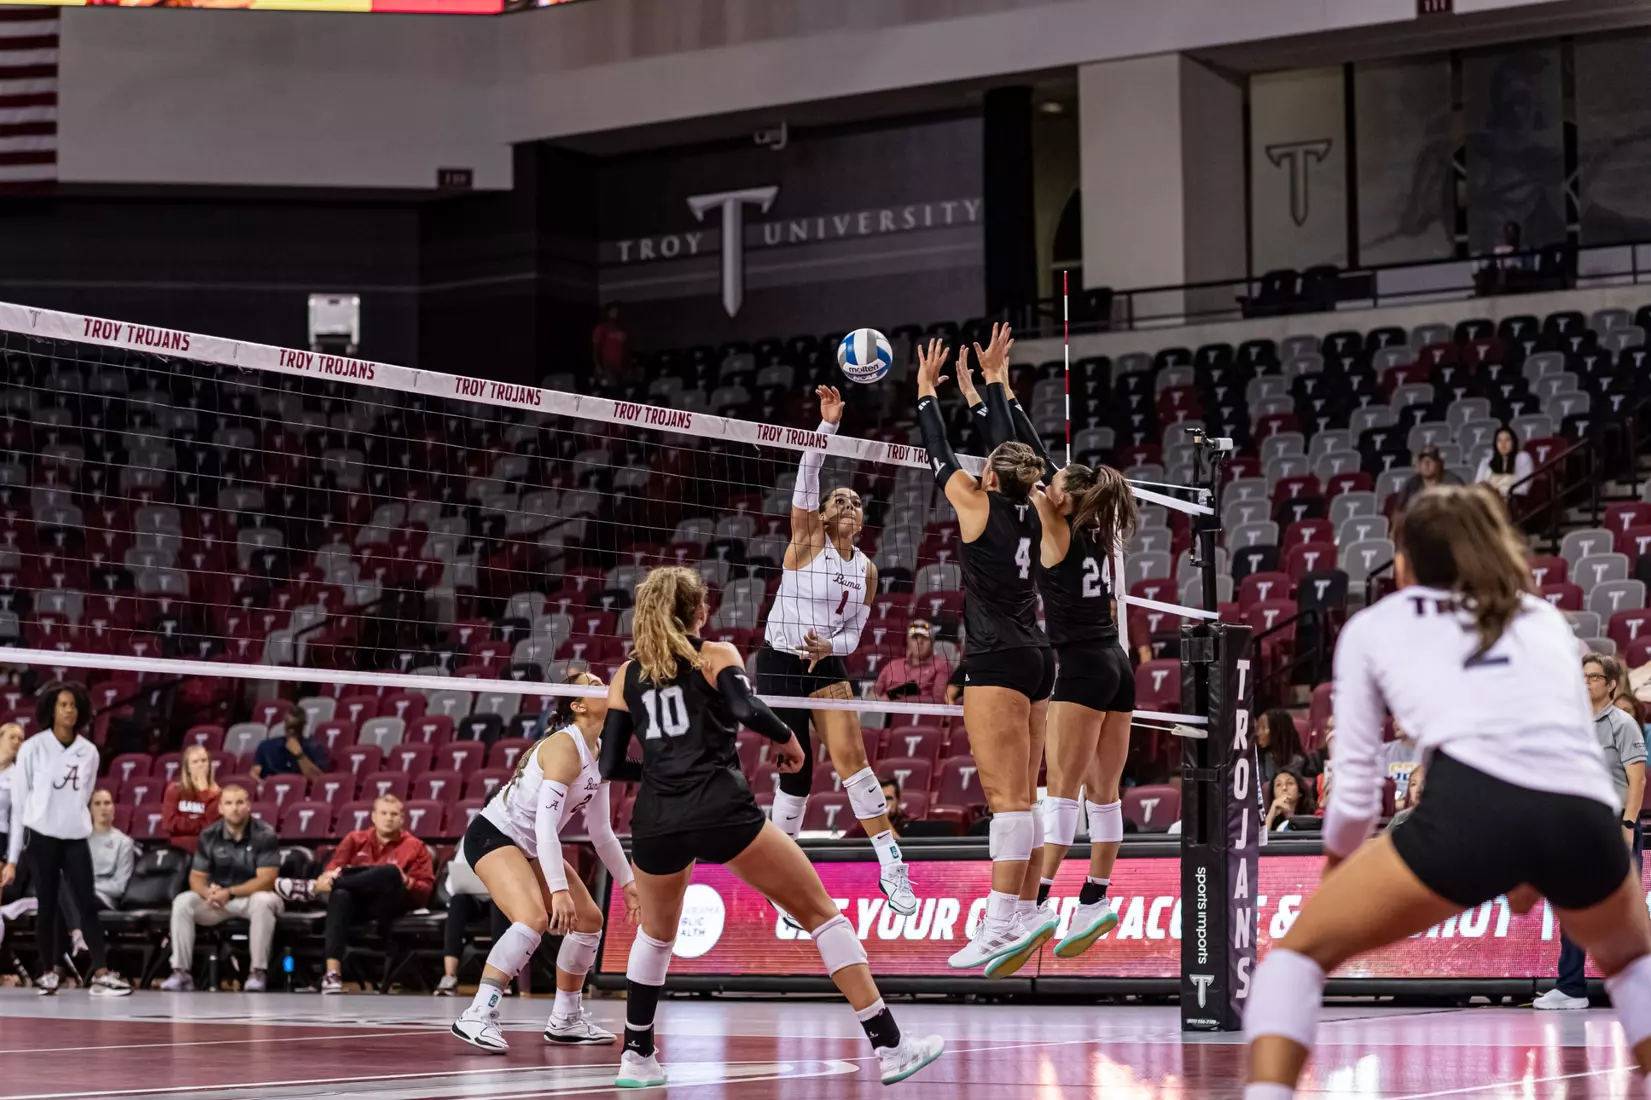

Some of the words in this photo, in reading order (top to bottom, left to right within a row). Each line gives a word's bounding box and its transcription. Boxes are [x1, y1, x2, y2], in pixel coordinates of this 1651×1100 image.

[617, 232, 703, 262] TROY
[763, 197, 981, 245] UNIVERSITY
[84, 318, 122, 341] TROY
[127, 324, 190, 351] TROJANS
[280, 349, 314, 370] TROY
[318, 355, 375, 381] TROJANS
[848, 363, 879, 373] molten
[455, 377, 486, 397] TROY
[490, 382, 541, 406] TROJANS
[613, 401, 643, 421] TROY
[645, 407, 692, 429] TROJANS
[757, 424, 782, 443] TROY
[786, 429, 828, 449] TROJANS
[887, 444, 911, 461] TROY
[1015, 537, 1031, 579] 4
[833, 572, 862, 590] Bama
[1082, 555, 1111, 598] 24
[835, 590, 849, 615] 1
[641, 685, 690, 739] 10
[53, 764, 80, 791] A
[570, 794, 593, 813] 2
[1233, 659, 1252, 999] TROJANS
[1195, 866, 1207, 910] sports
[855, 897, 959, 940] YOUR
[1196, 911, 1208, 965] imports
